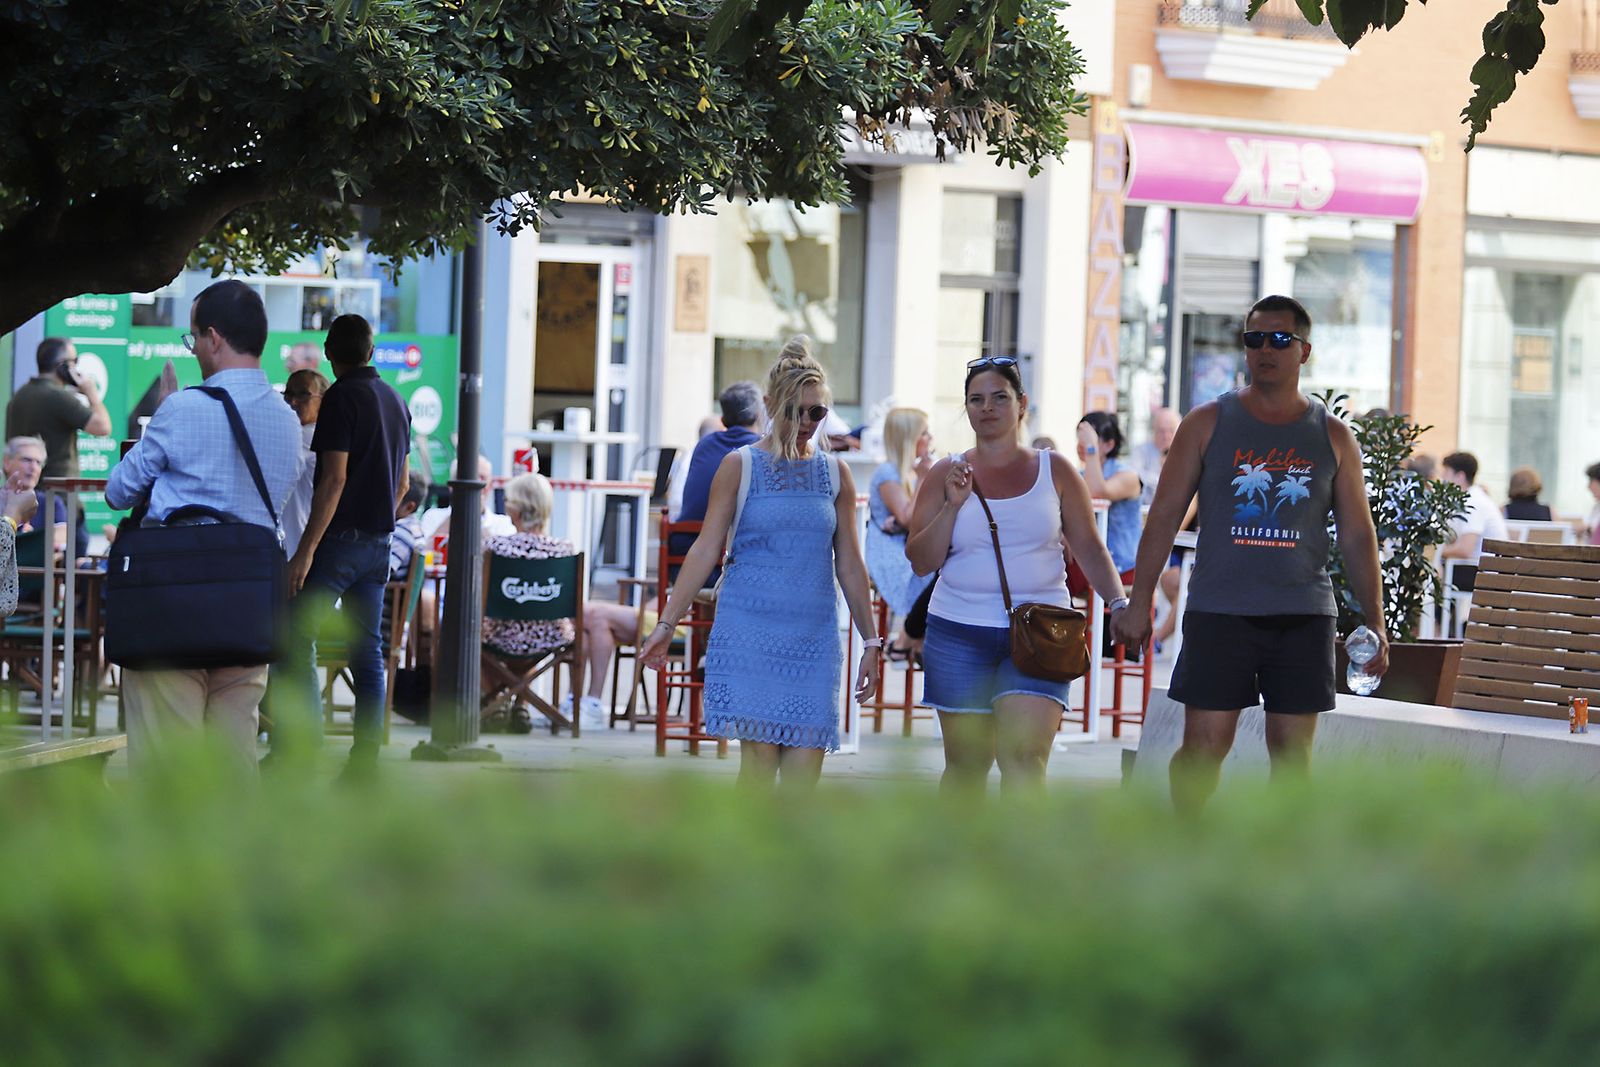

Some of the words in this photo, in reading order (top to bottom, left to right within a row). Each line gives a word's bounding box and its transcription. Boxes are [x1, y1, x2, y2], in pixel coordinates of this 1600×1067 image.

[1223, 136, 1336, 210] XES
[66, 311, 114, 329] domingo
[1231, 526, 1300, 540] CALIFORNIA
[501, 576, 563, 604] Carlsberg
